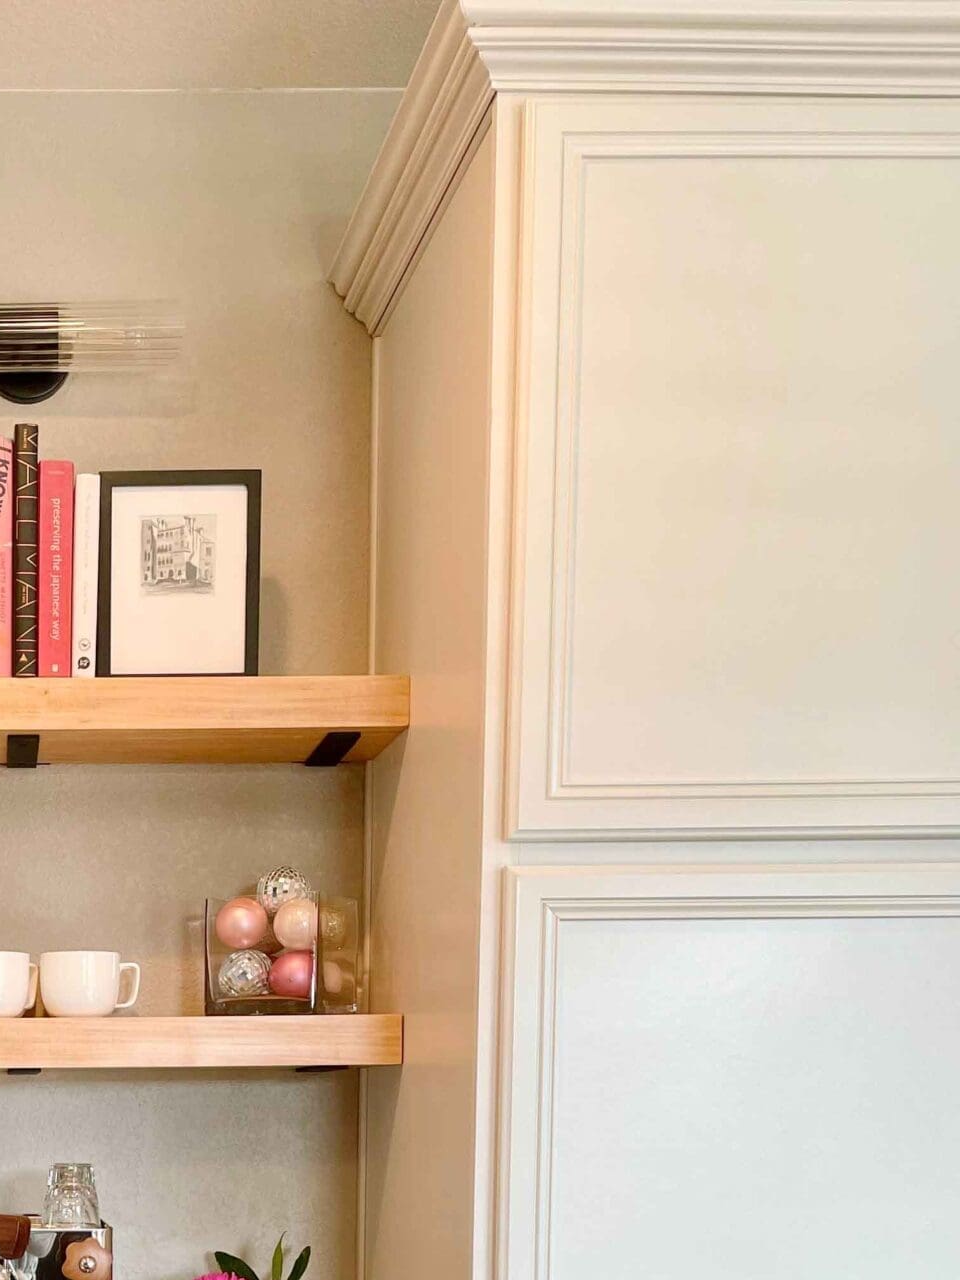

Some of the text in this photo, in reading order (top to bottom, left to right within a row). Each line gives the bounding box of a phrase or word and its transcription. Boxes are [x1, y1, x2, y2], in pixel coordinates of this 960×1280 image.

[49, 497, 62, 640] preserving the japanese way
